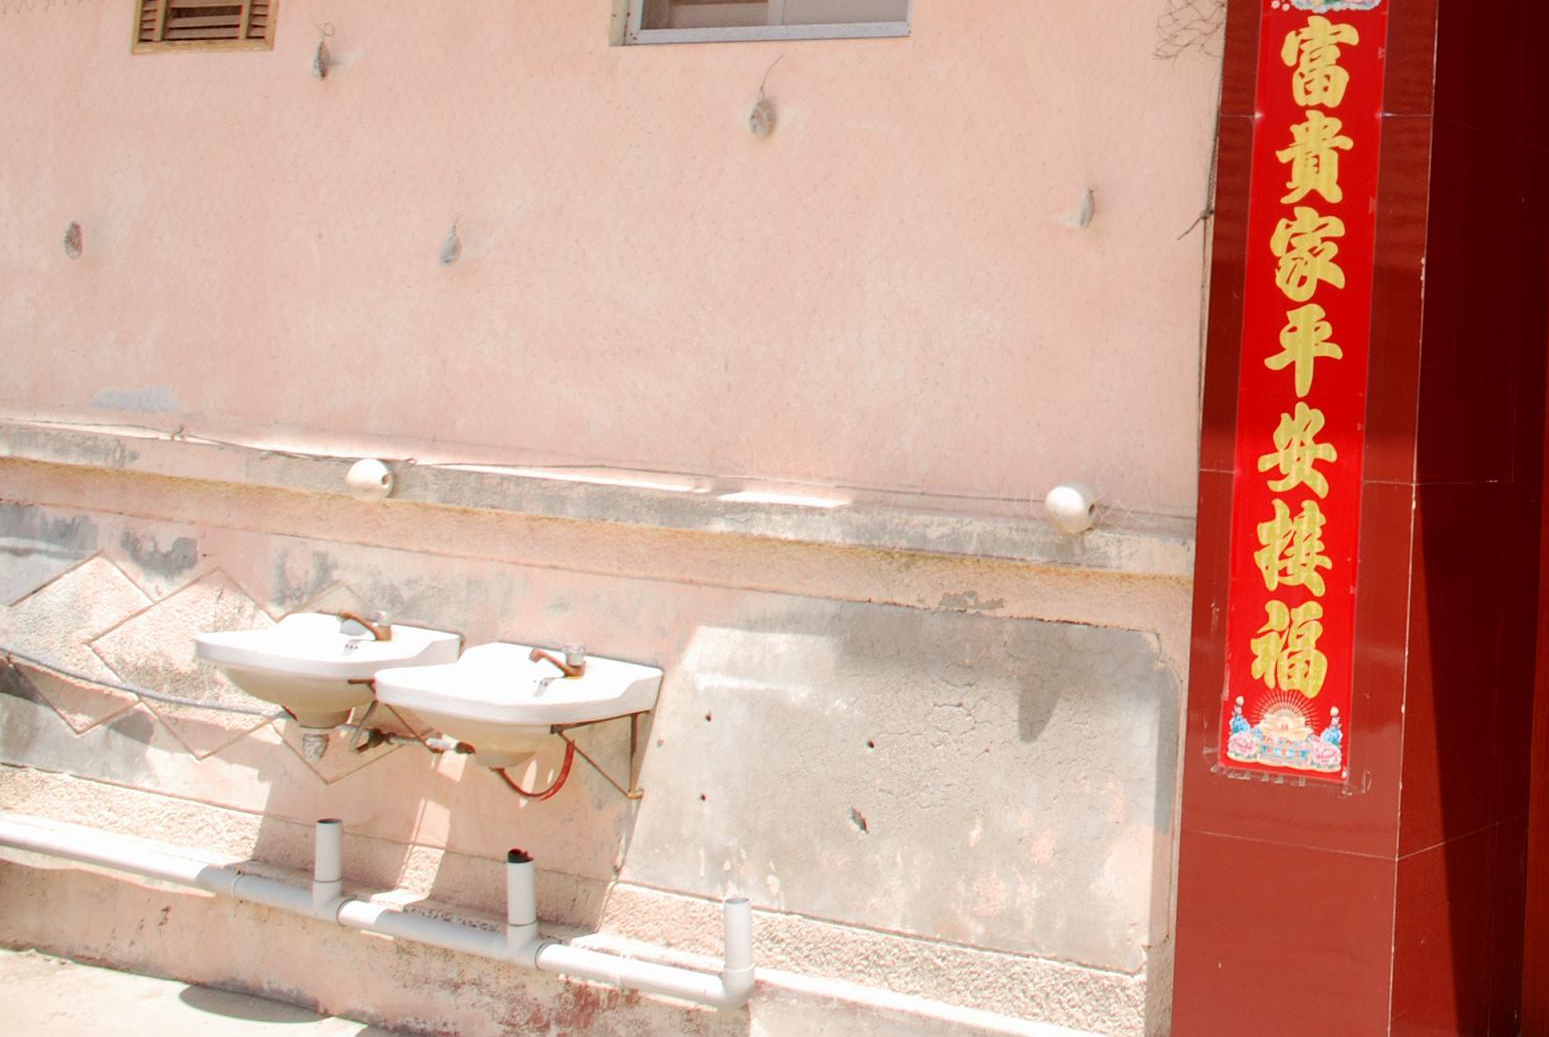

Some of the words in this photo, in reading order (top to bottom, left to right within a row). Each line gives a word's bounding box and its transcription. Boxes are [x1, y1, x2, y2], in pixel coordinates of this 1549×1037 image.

[1250, 15, 1359, 699] 富貴家平安接福
